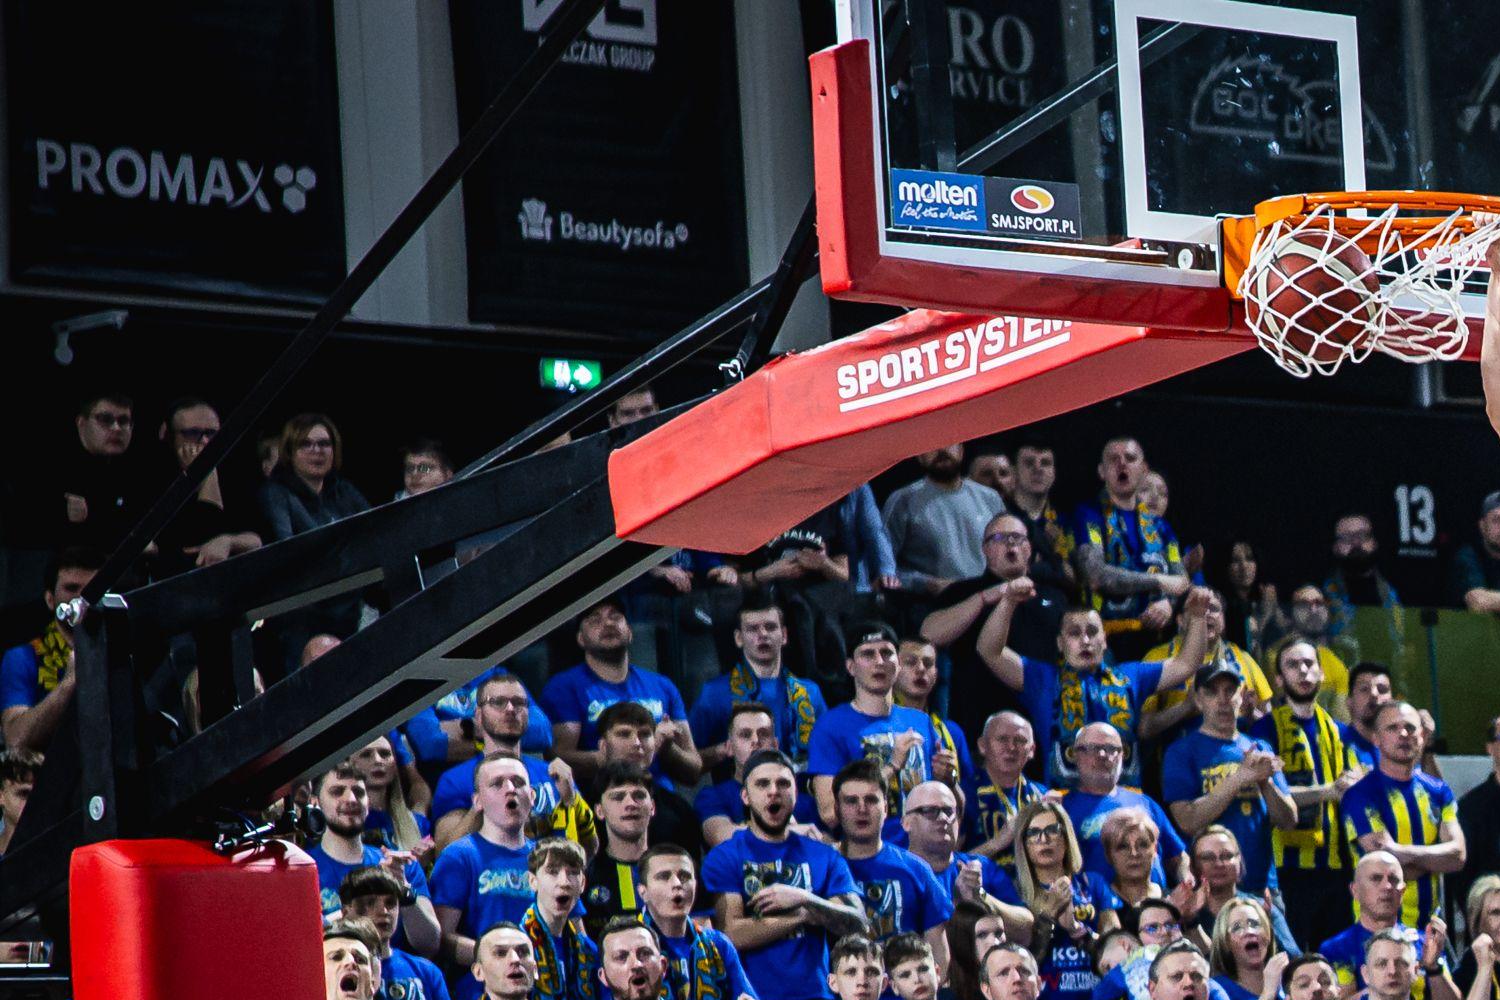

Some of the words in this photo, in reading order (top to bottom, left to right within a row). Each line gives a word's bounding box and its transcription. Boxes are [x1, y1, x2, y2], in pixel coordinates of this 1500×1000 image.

[36, 137, 271, 212] PROMAX
[899, 180, 977, 207] molten
[992, 213, 1077, 235] SMJSPORT.PL
[1394, 484, 1436, 544] 13
